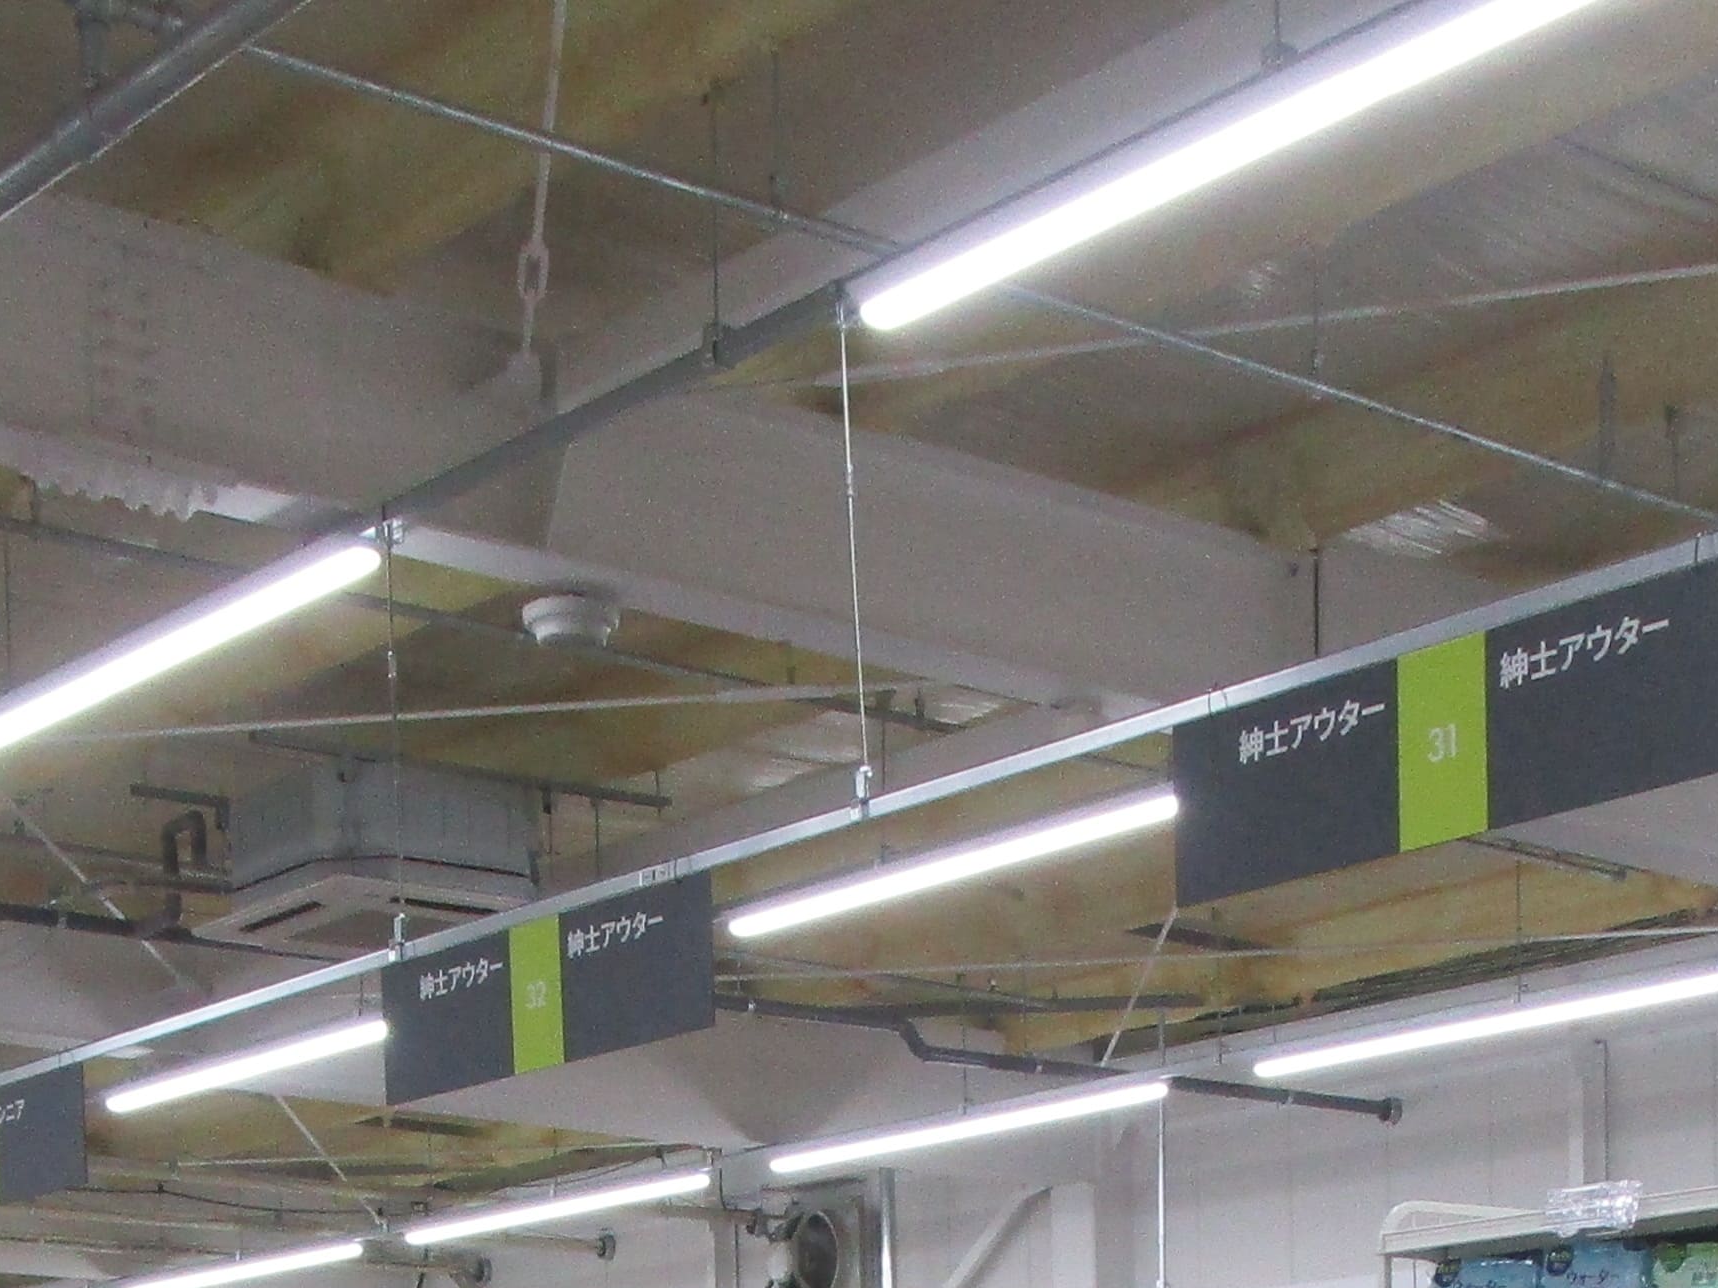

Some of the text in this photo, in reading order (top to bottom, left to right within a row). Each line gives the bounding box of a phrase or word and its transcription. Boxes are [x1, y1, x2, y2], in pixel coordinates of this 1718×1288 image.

[1499, 616, 1669, 689] 紳士アウター
[1239, 701, 1384, 765] 紳士アウター
[1428, 724, 1458, 763] 31
[567, 912, 664, 959] 紳士アウター
[419, 957, 504, 1000] 紳士アウター
